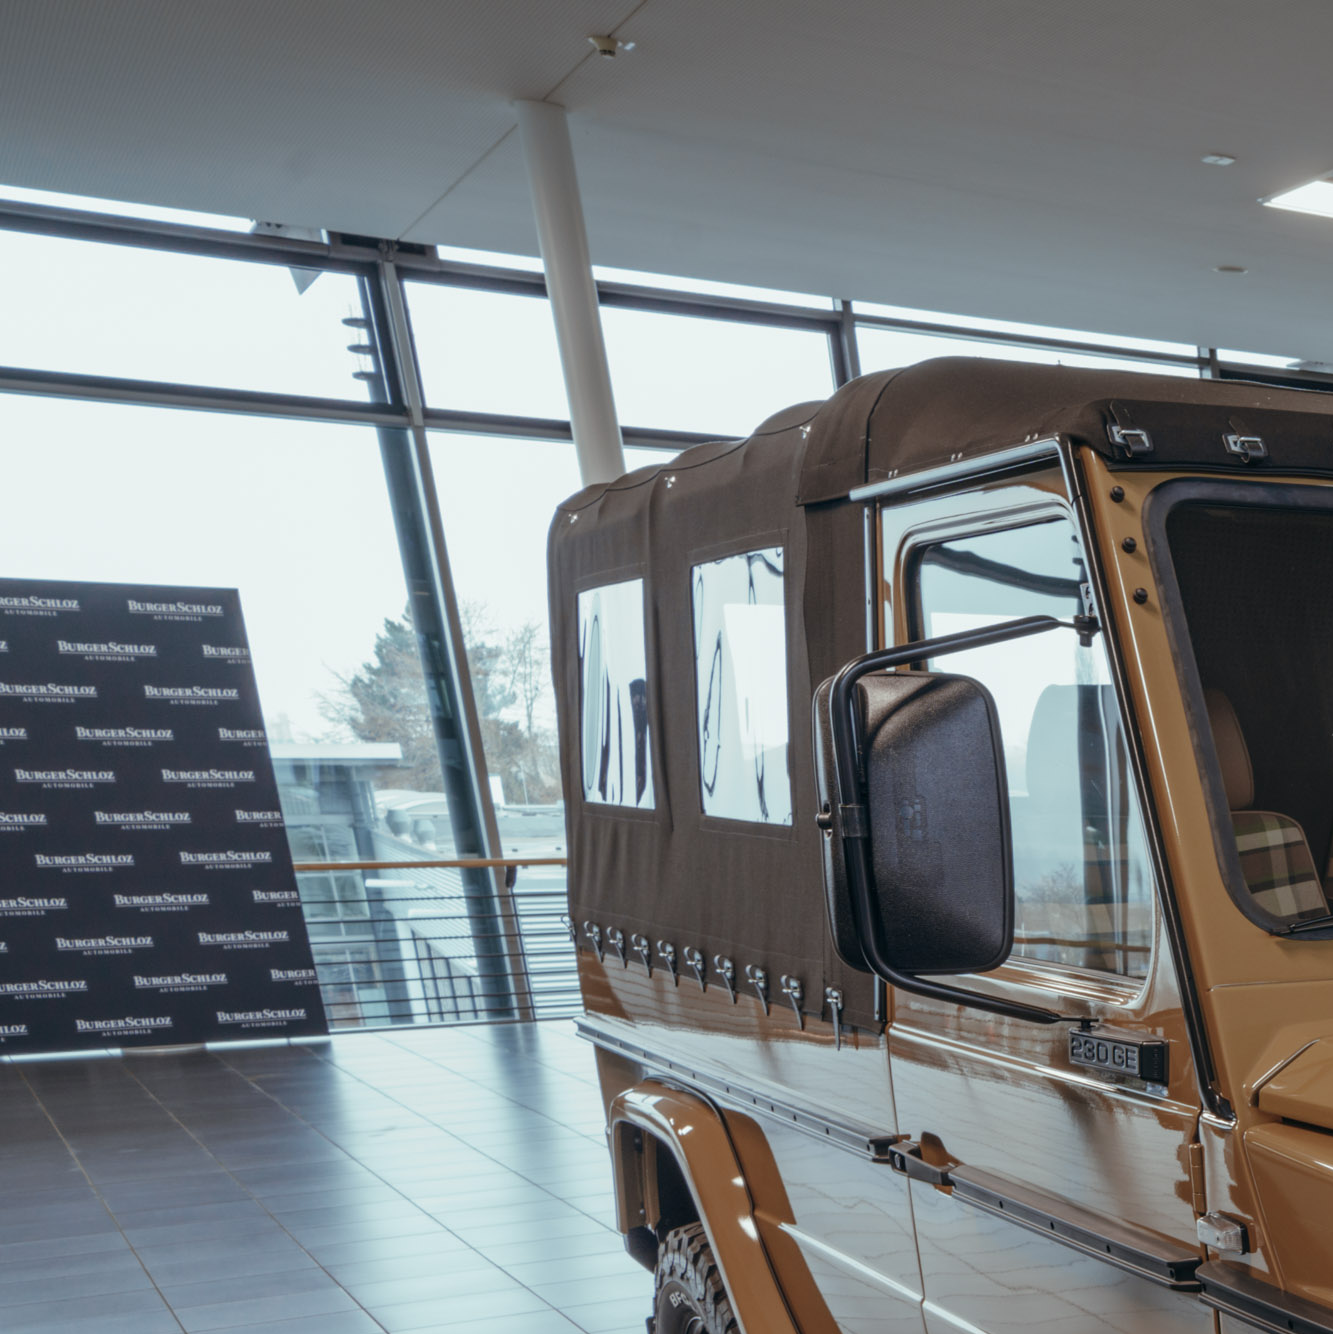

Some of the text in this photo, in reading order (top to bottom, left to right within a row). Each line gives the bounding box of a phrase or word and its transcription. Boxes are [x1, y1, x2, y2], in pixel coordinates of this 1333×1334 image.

[0, 596, 79, 608] RGERSCHLOZ
[1071, 1036, 1138, 1070] 230 GE
